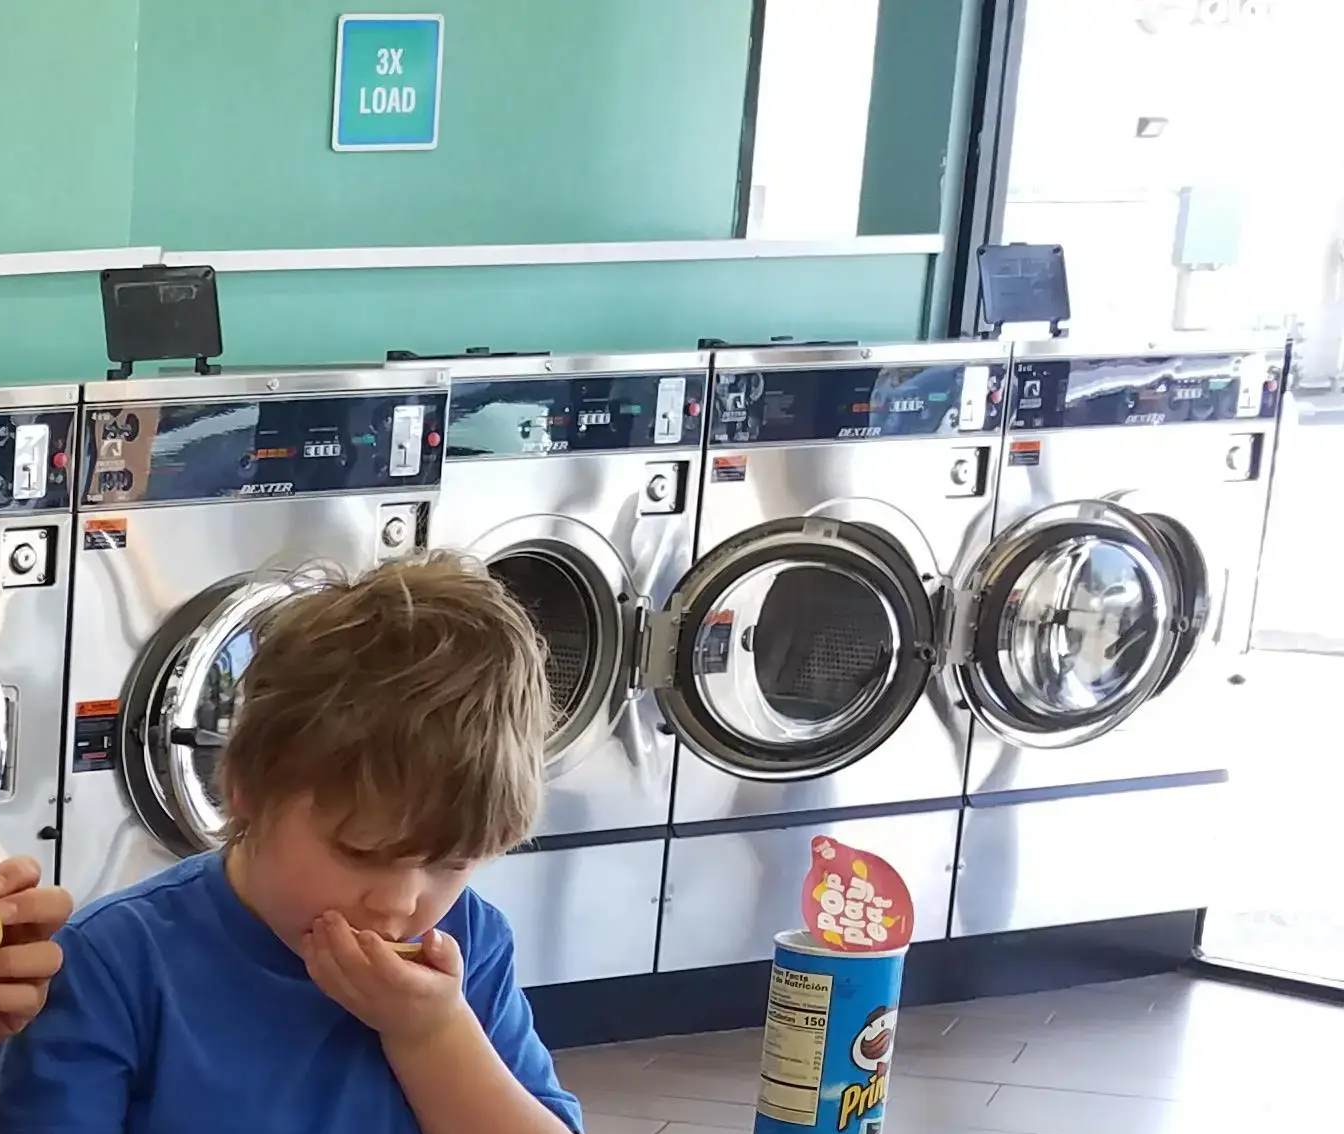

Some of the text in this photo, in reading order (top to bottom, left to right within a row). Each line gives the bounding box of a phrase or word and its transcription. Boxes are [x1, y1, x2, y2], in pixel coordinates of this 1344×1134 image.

[376, 48, 404, 75] 3X
[359, 86, 416, 114] LOAD
[839, 426, 882, 437] DEXTER
[239, 482, 294, 495] DEXTER
[839, 877, 874, 946] play
[866, 896, 893, 942] eat
[804, 1016, 826, 1027] 150
